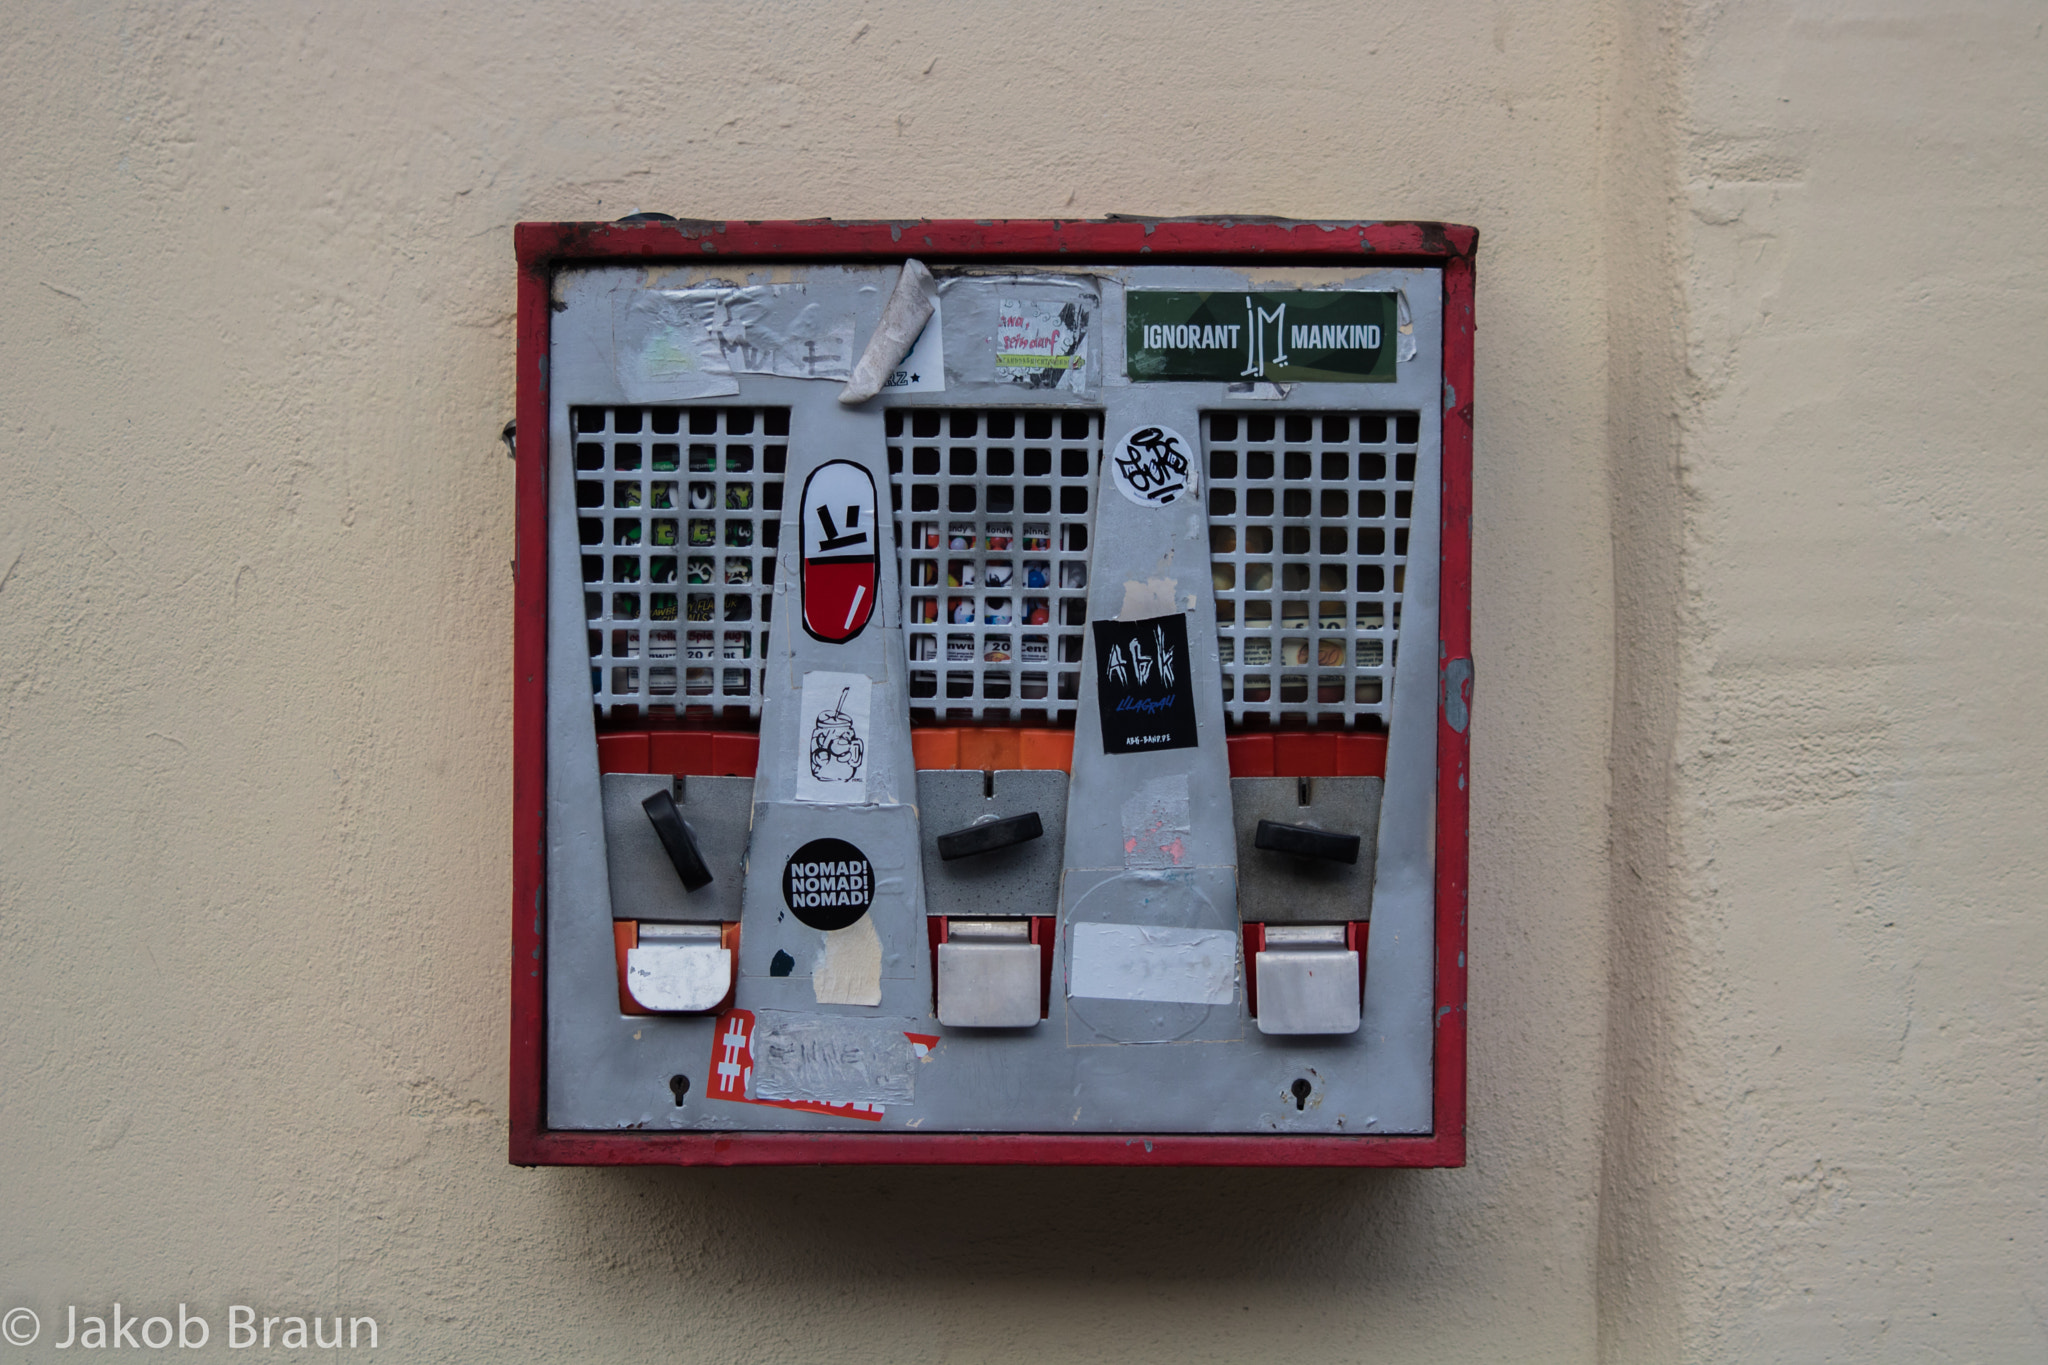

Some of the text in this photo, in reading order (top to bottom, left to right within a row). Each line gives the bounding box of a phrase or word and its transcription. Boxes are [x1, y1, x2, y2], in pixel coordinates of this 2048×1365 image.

[1143, 324, 1241, 350] IGNORANT
[1291, 324, 1381, 350] MANKIND
[688, 651, 704, 659] 20
[993, 643, 1010, 651] 20
[791, 860, 868, 878] NOMAD!
[792, 875, 869, 893] NOMAD!
[792, 890, 869, 908] NOMAD!
